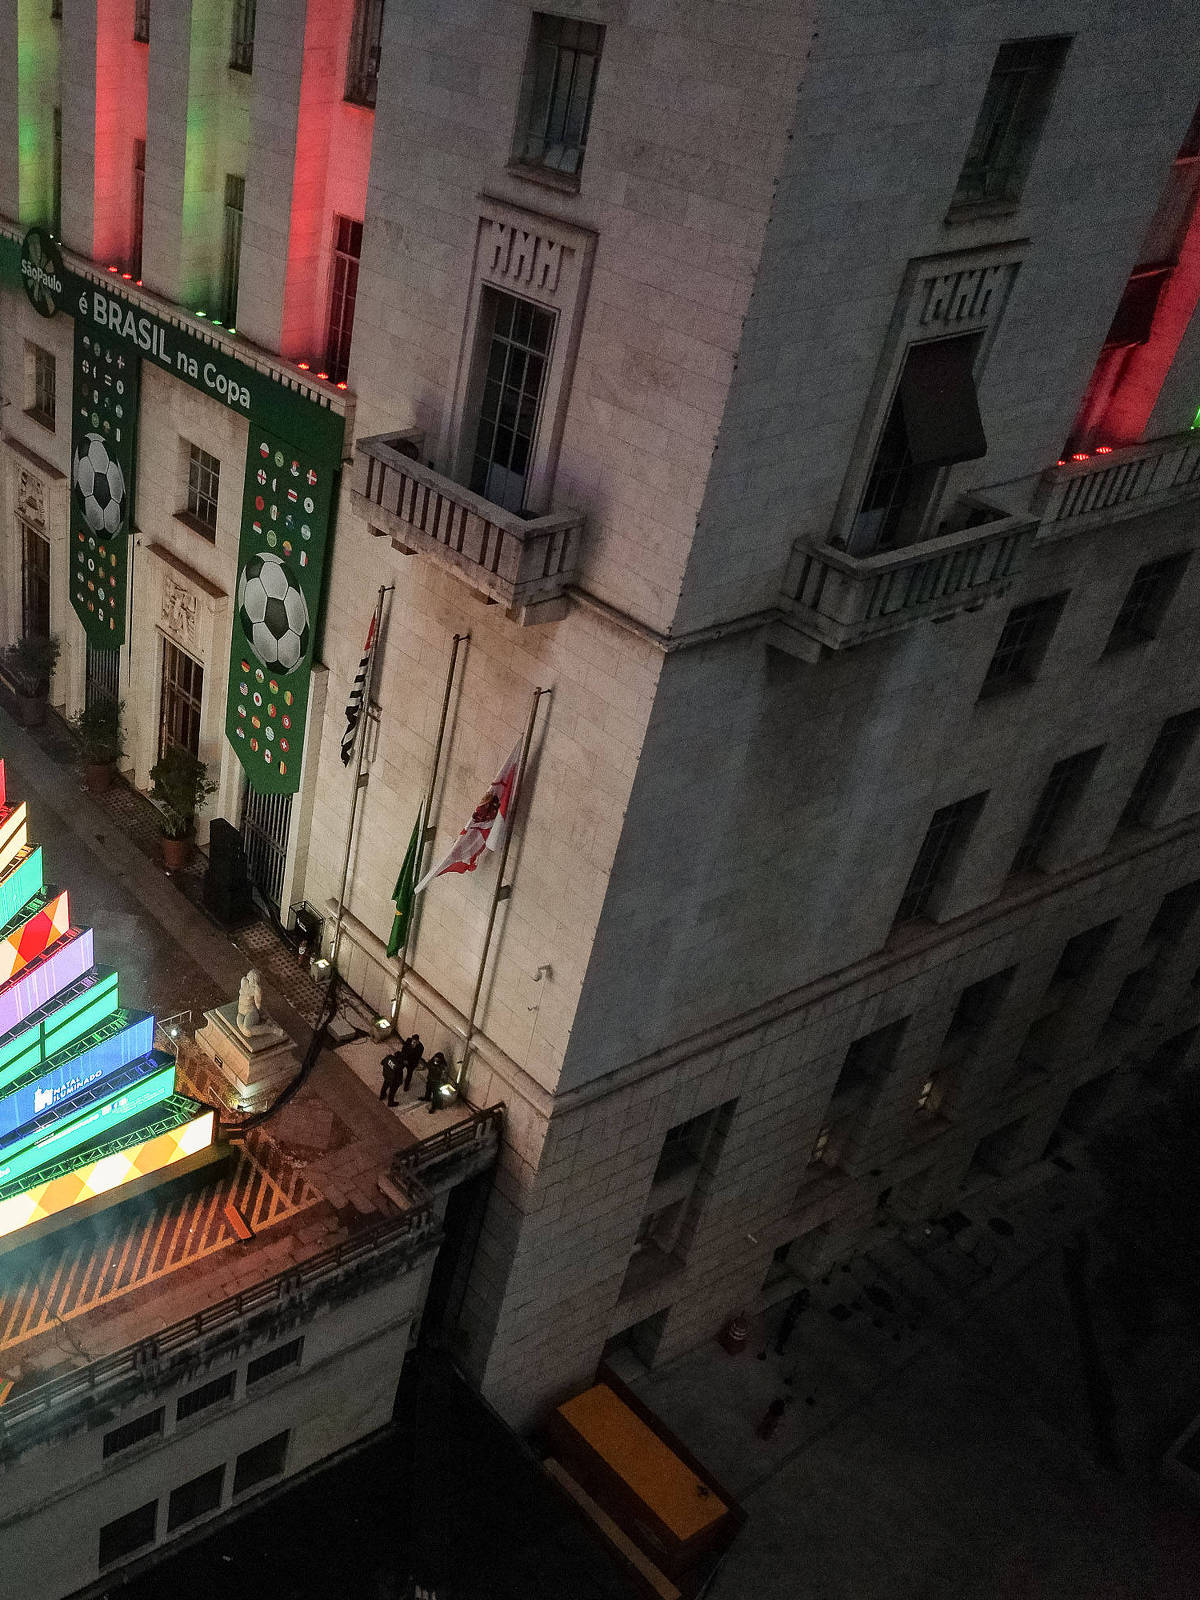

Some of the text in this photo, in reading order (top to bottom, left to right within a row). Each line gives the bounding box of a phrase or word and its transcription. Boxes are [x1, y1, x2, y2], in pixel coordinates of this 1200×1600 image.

[78, 291, 251, 409] é BRASIL na Copa
[53, 1069, 103, 1102] ILUMINADO
[53, 1076, 81, 1096] NATAL
